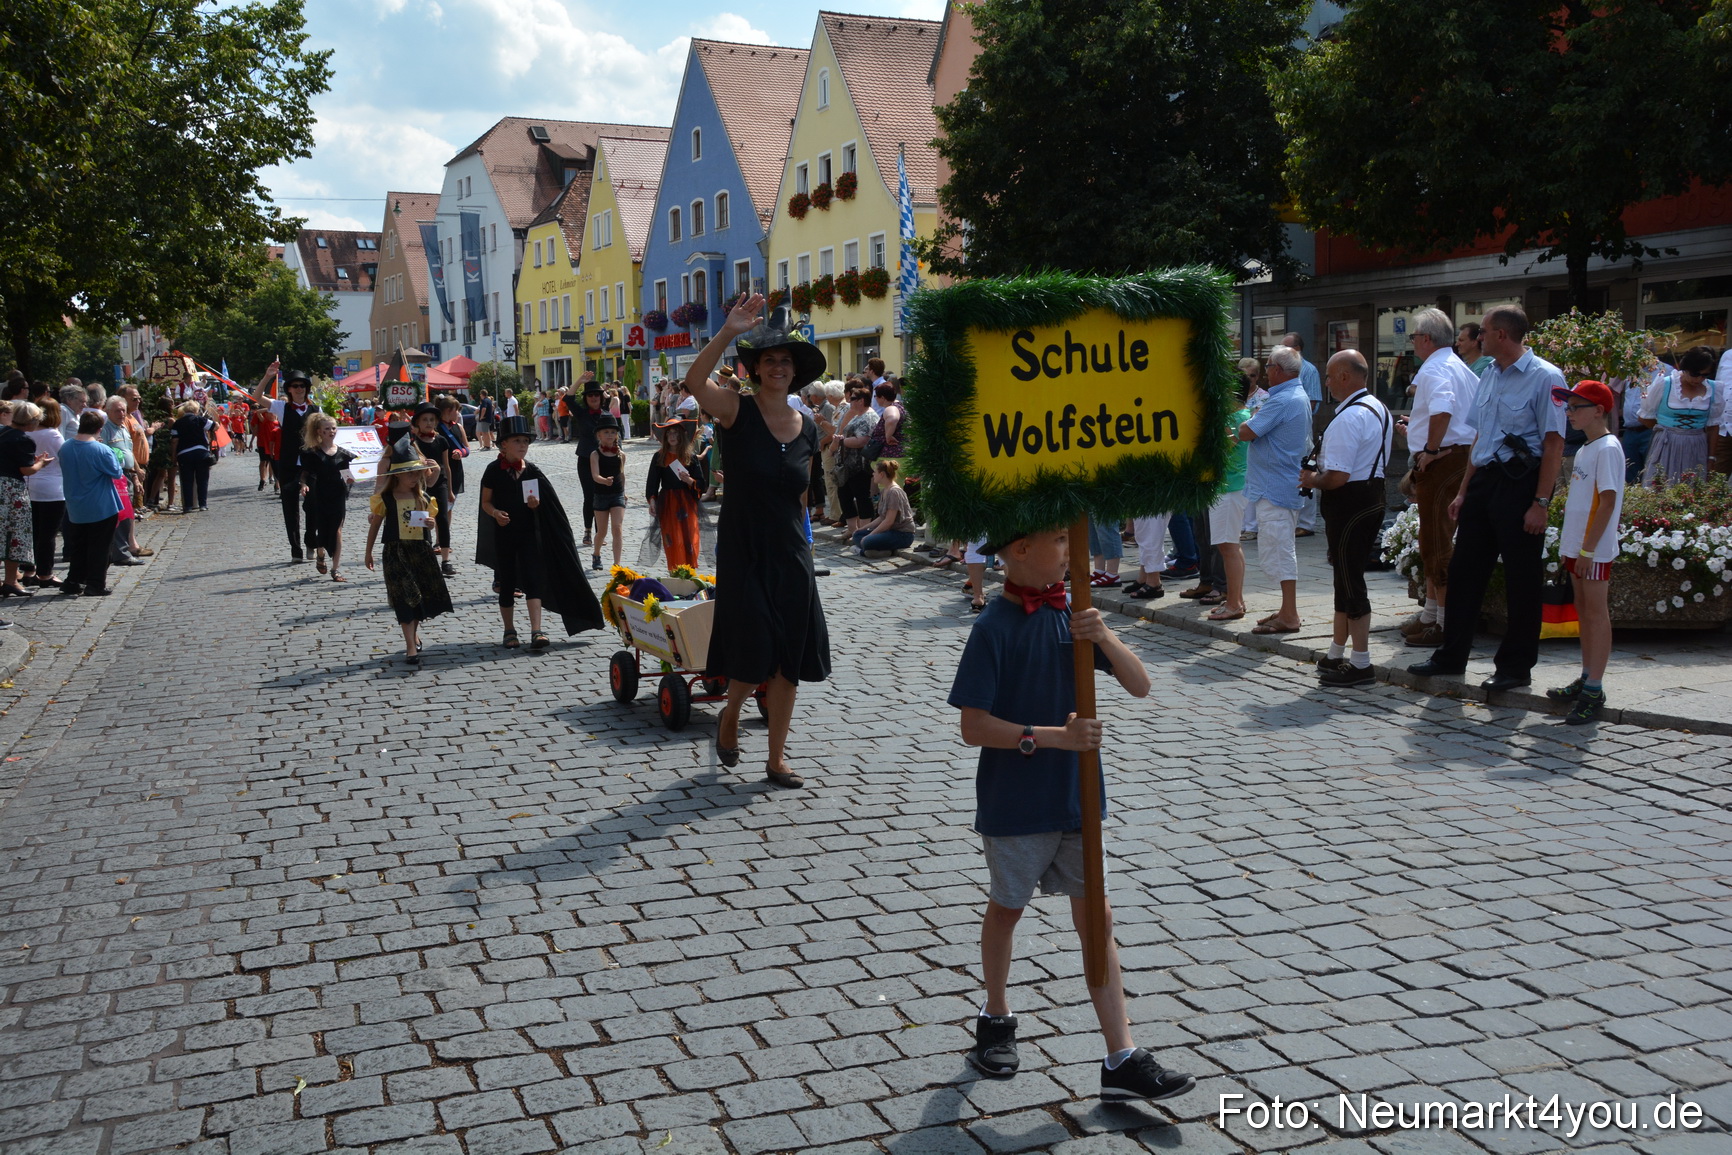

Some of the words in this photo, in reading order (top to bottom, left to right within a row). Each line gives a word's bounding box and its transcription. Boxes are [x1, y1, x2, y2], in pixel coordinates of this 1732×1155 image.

[541, 280, 557, 294] HOTEL
[802, 327, 811, 338] P
[654, 332, 691, 350] APOTHEKE
[542, 345, 563, 355] Restaurant
[1010, 329, 1150, 381] Schule
[391, 386, 413, 396] BSC
[983, 396, 1179, 459] Wolfstein
